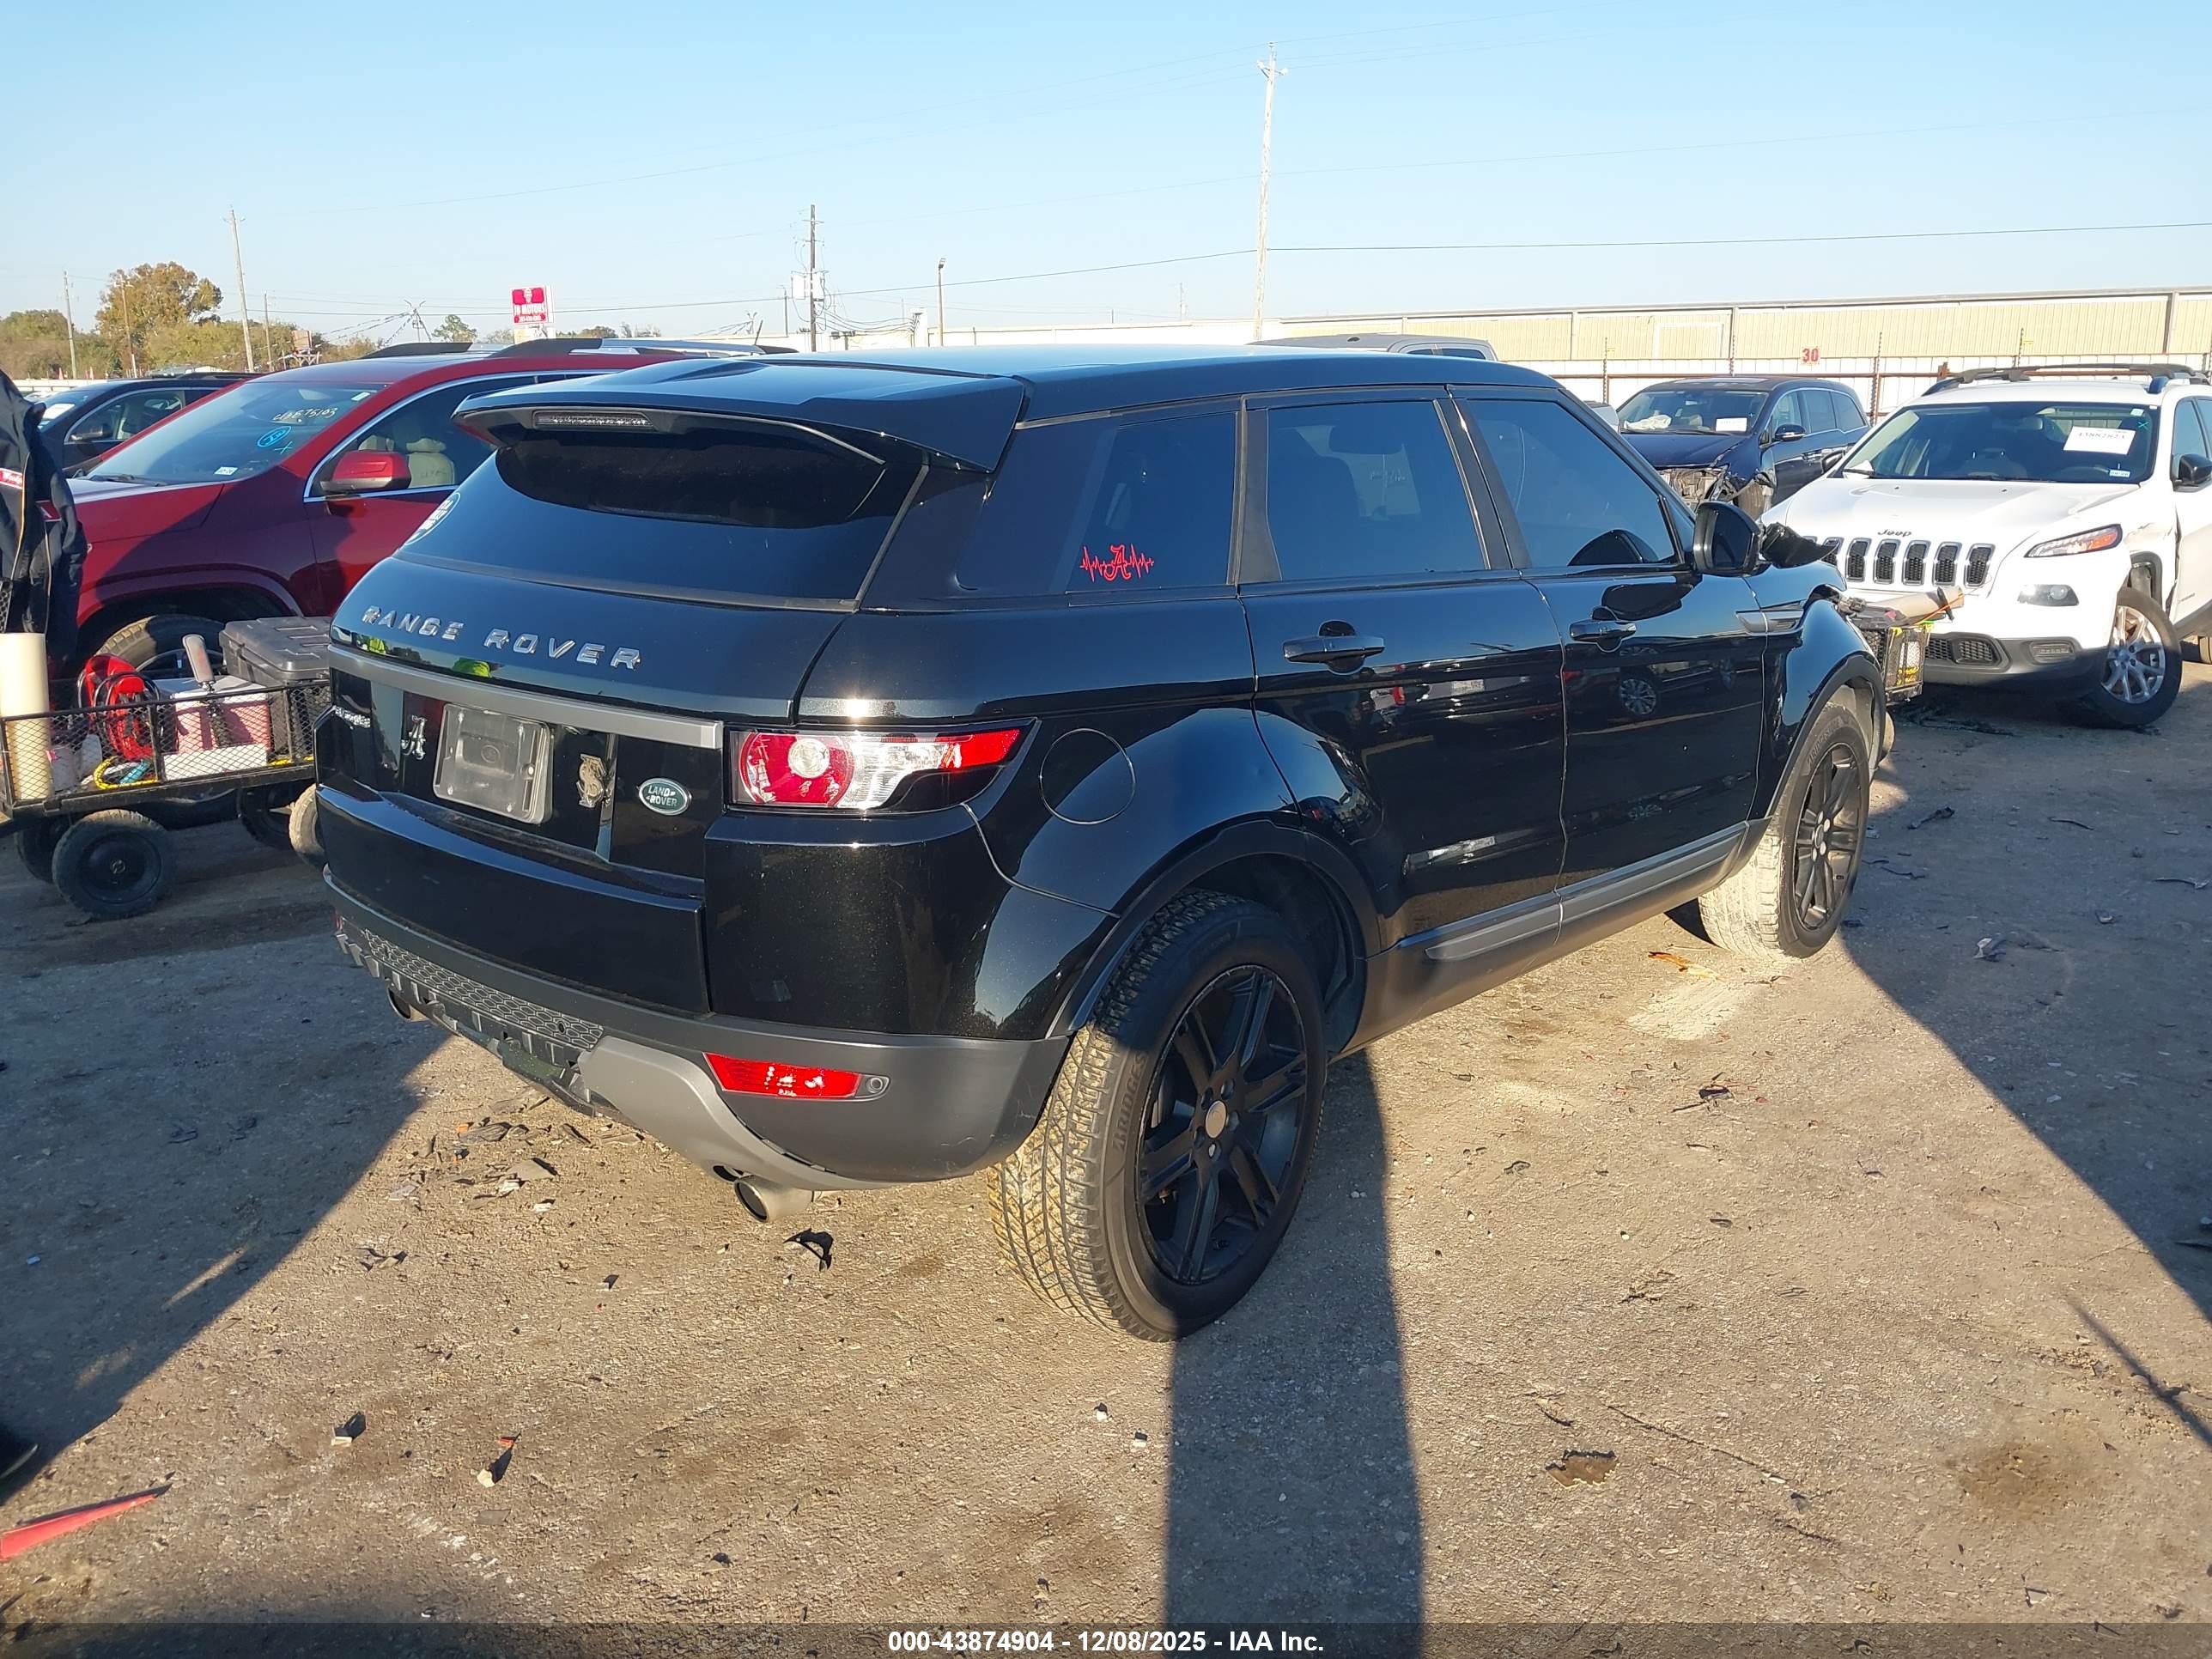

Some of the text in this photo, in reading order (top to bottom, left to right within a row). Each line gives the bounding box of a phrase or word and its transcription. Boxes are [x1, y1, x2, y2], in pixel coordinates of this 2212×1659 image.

[1802, 347, 1819, 362] 30
[1877, 528, 1912, 538] Jeep
[362, 605, 641, 671] RANGE ROVER
[647, 784, 672, 798] LAND
[649, 794, 678, 807] ROVER
